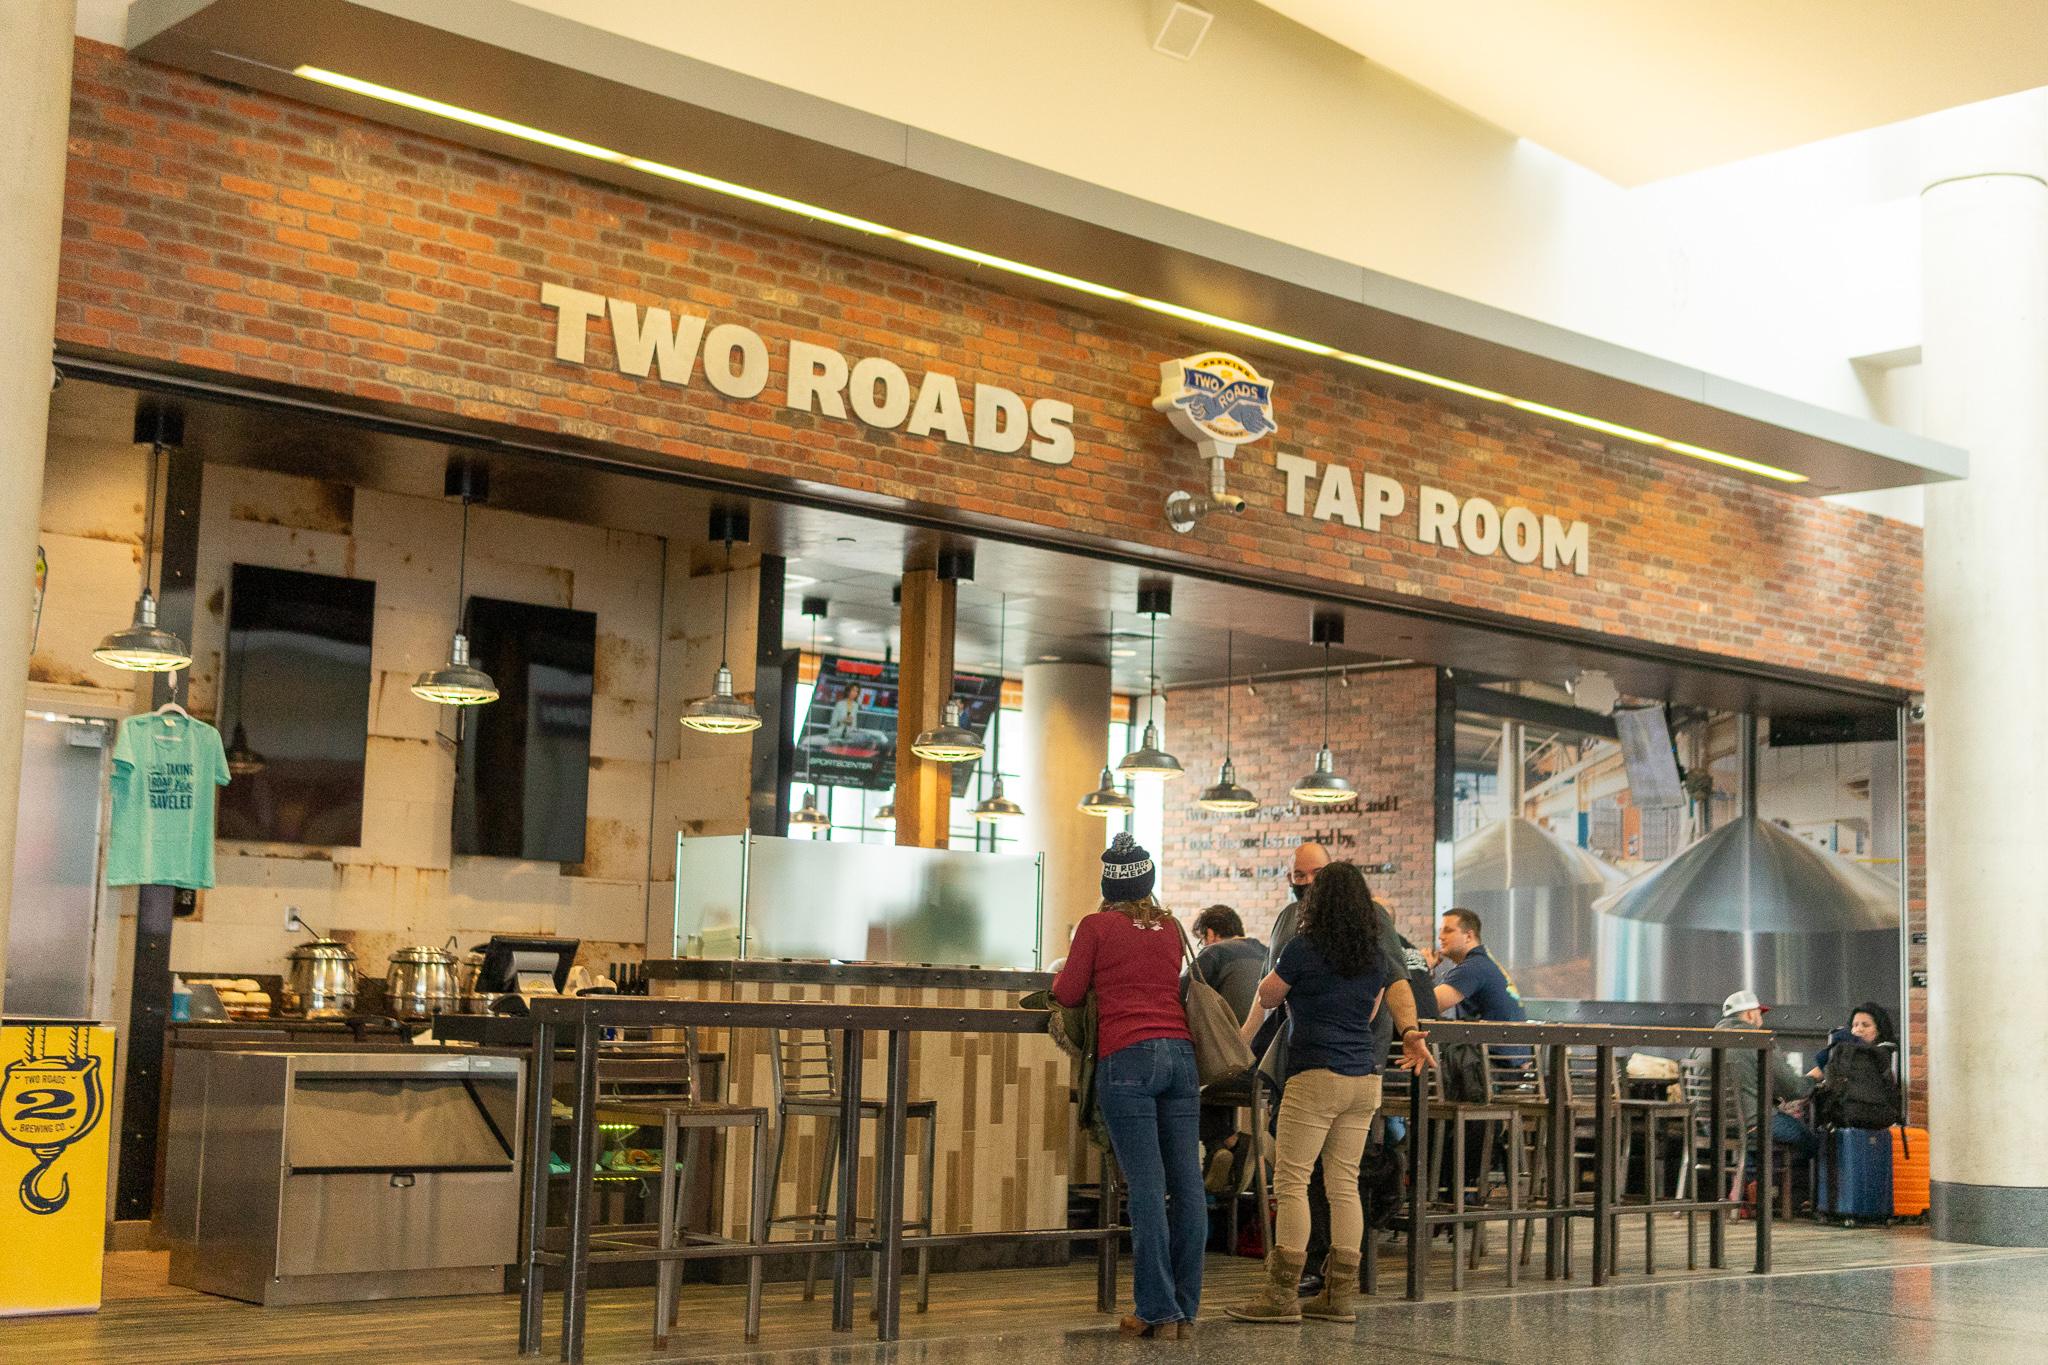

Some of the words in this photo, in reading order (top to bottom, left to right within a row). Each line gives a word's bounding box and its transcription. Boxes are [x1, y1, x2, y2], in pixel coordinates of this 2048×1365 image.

[541, 282, 769, 399] TWO
[786, 339, 1075, 465] ROADS
[1194, 373, 1219, 391] TWO
[1219, 383, 1258, 409] ROADS
[1276, 452, 1404, 532] TAP
[1418, 484, 1589, 576] ROOM
[809, 757, 873, 770] SPORTSCENTER
[1121, 860, 1149, 872] ROADS
[25, 1075, 40, 1084] TWO
[42, 1075, 66, 1084] ROADS
[15, 1089, 77, 1120] 2
[20, 1123, 54, 1133] BREWING
